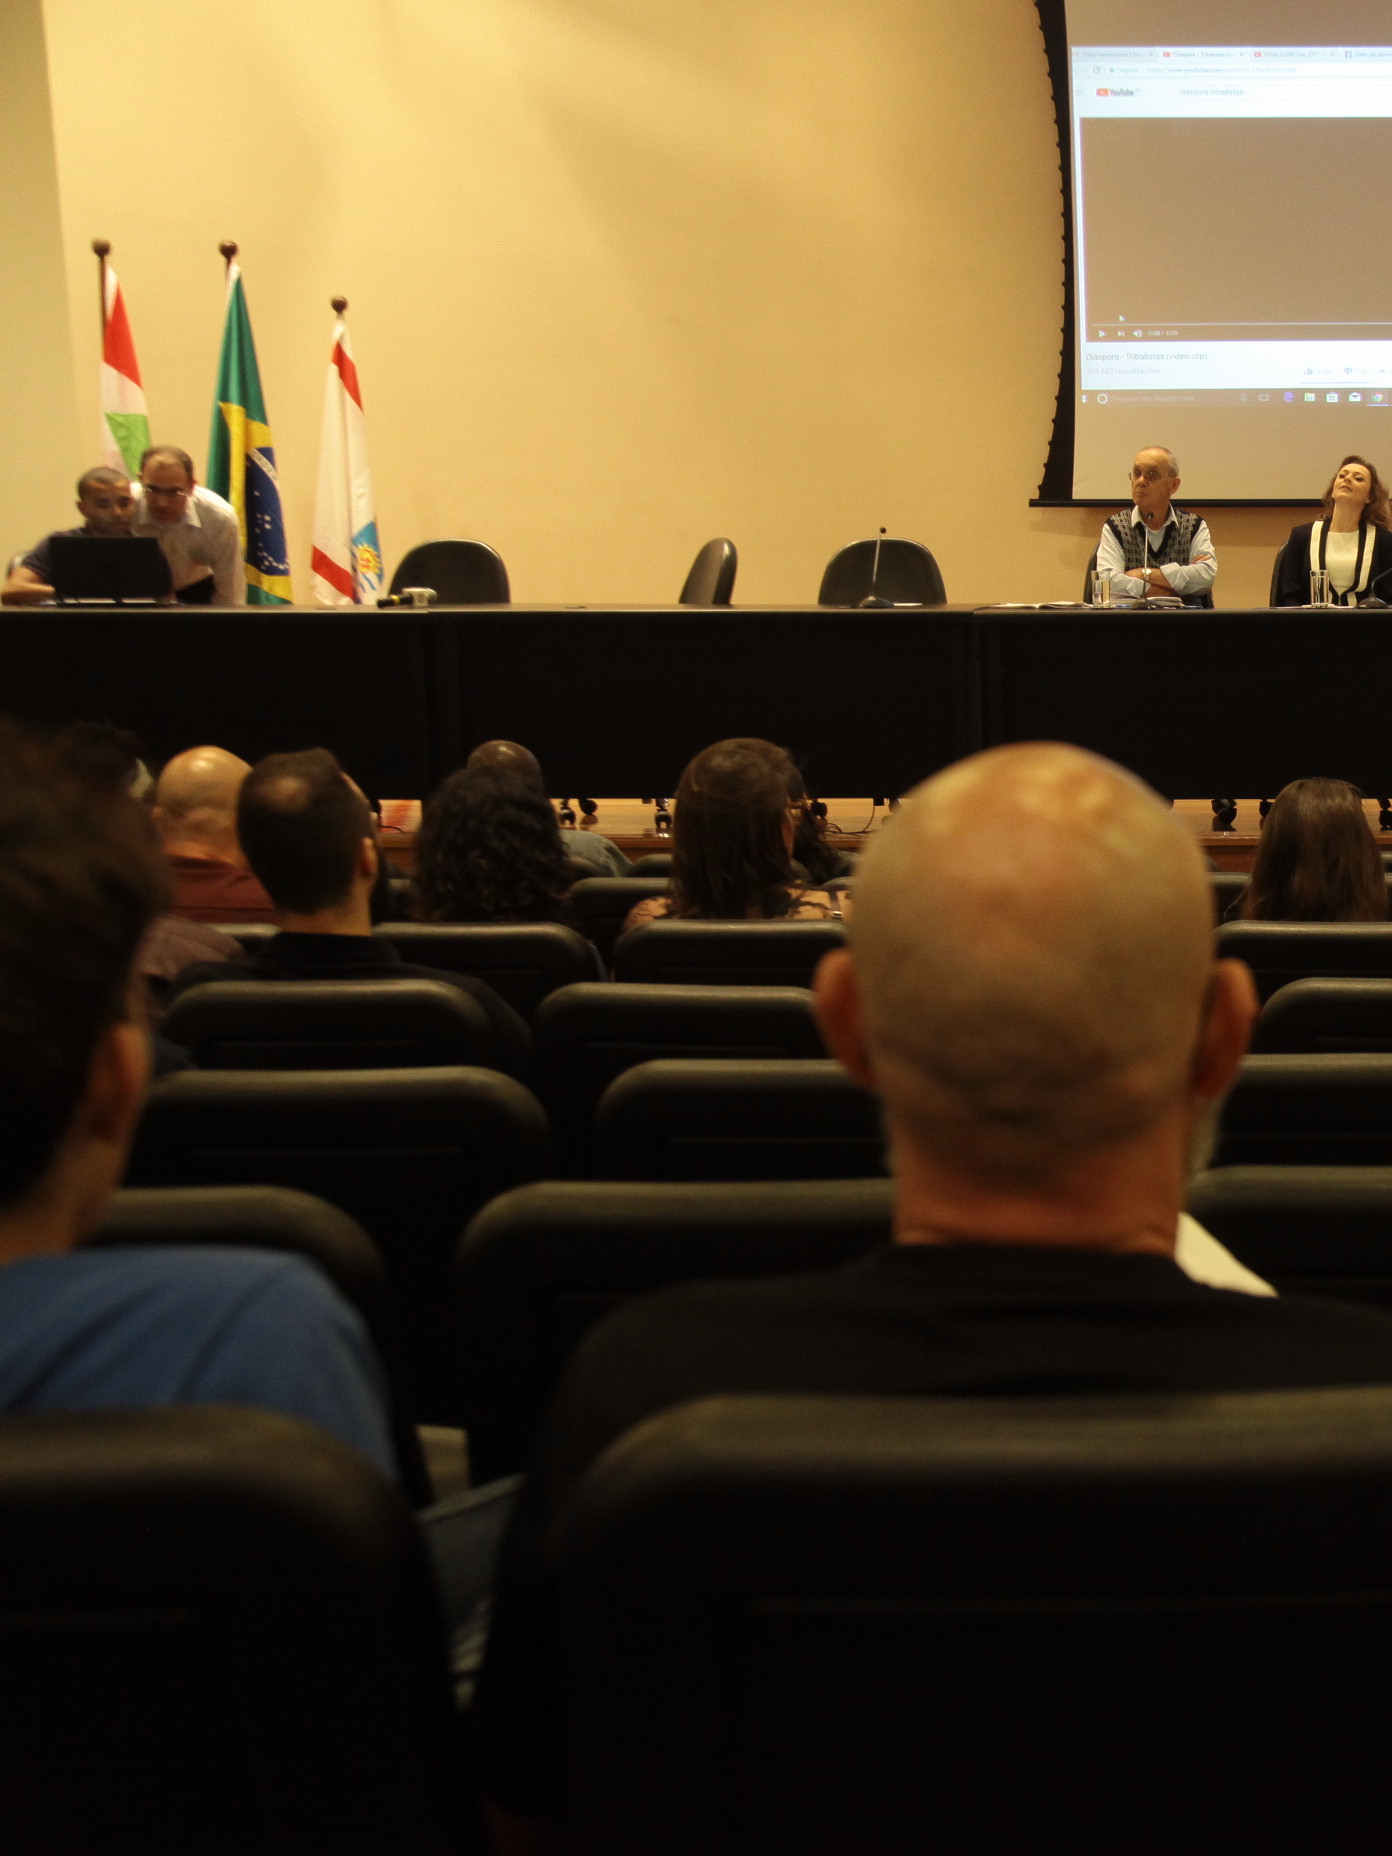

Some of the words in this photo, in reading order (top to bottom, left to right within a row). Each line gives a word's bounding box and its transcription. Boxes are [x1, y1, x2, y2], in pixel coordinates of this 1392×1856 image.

[1085, 353, 1120, 363] Diáspora
[1126, 352, 1165, 361] Tribalistas
[1191, 352, 1208, 362] clip)
